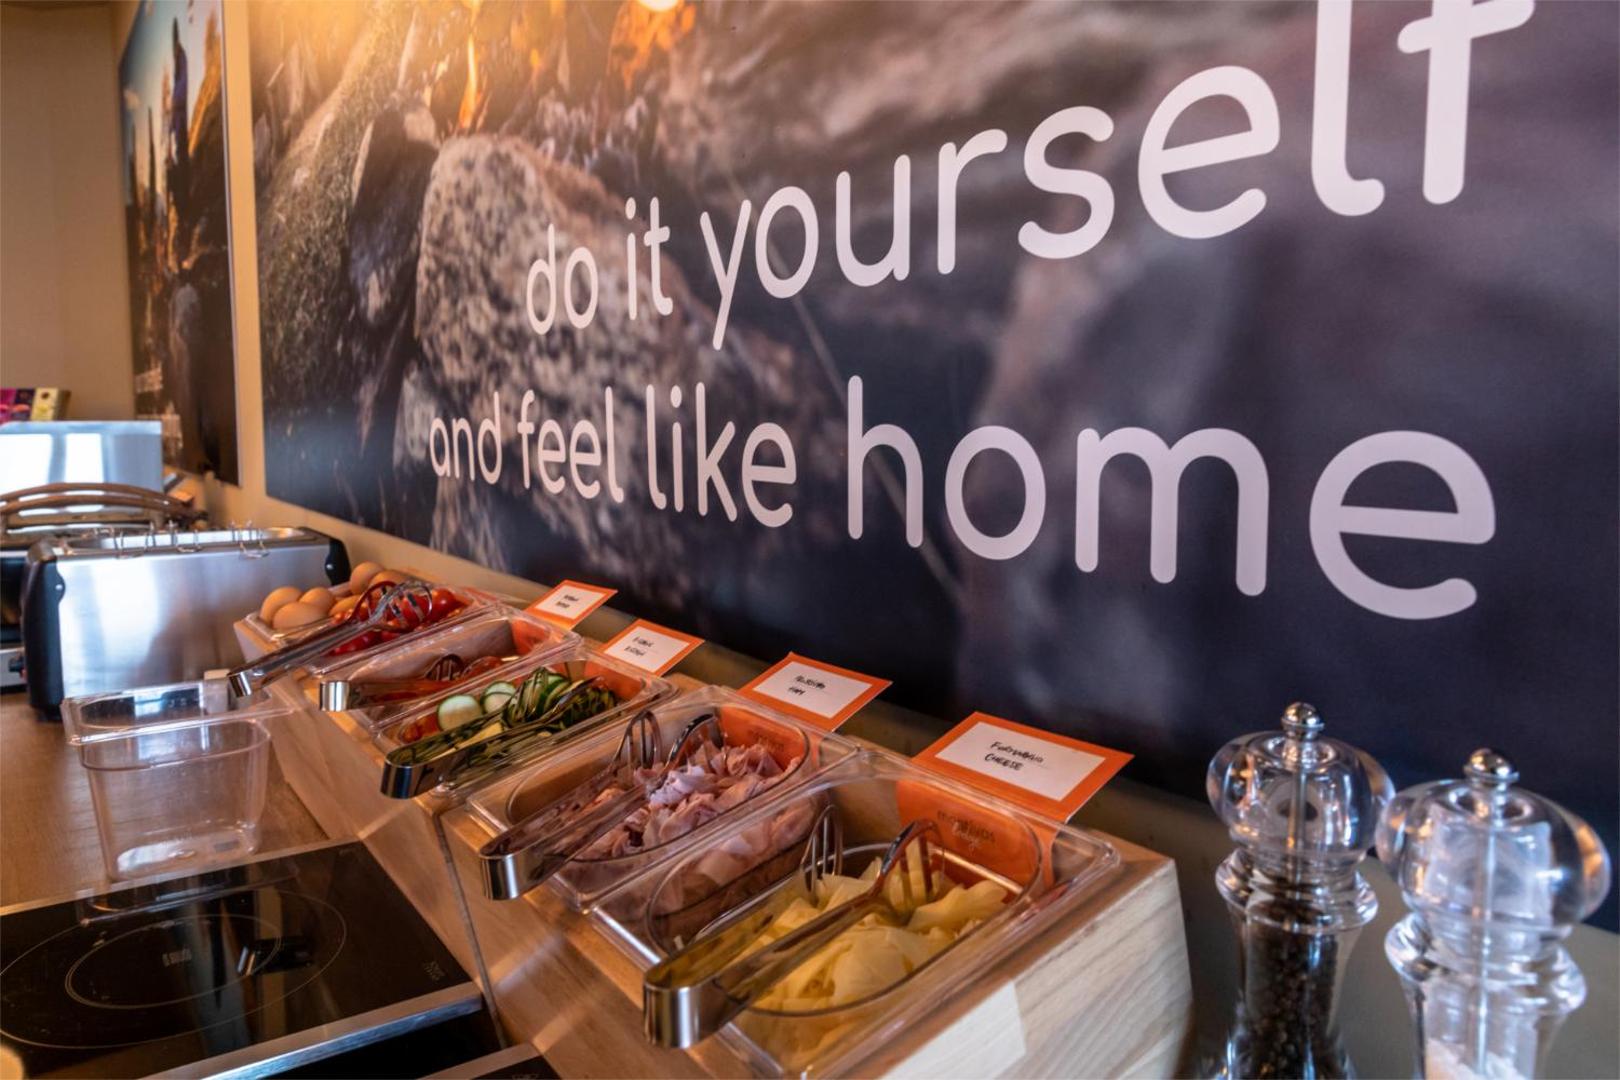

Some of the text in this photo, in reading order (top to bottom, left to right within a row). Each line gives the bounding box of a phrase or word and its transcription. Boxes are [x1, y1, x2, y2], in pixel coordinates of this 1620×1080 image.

[526, 0, 1535, 350] do it yourself
[429, 375, 1497, 620] and feel like home
